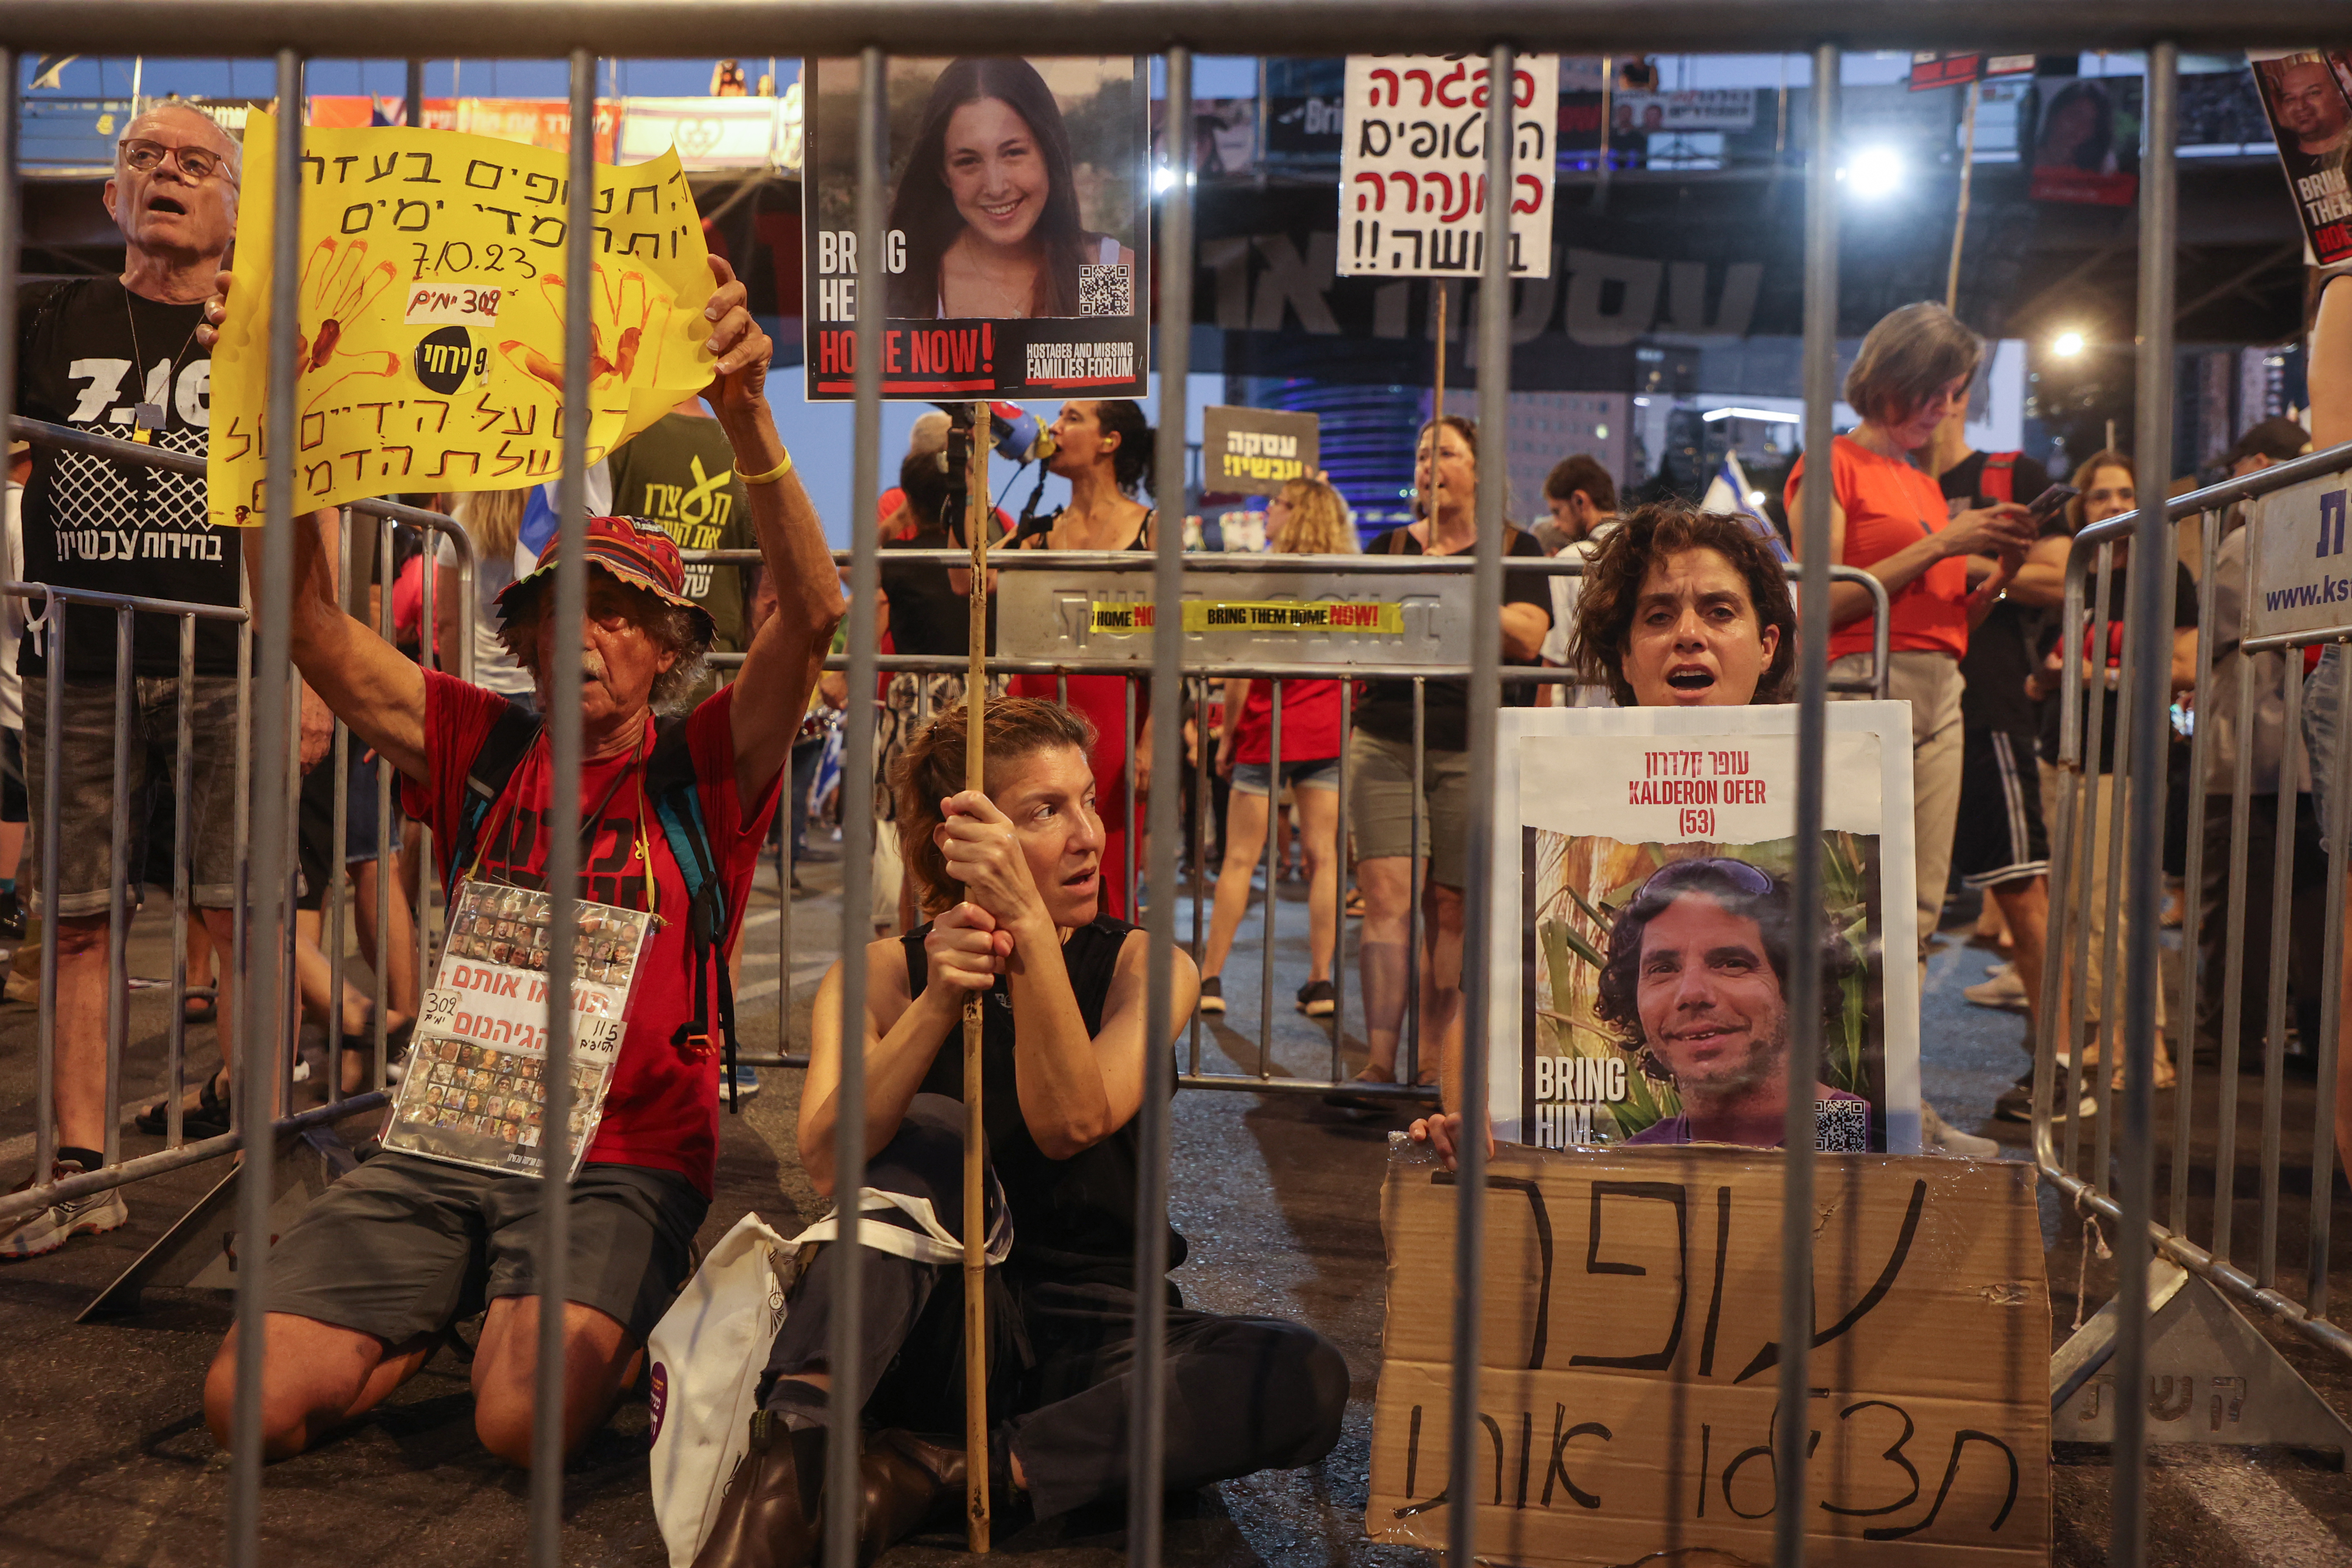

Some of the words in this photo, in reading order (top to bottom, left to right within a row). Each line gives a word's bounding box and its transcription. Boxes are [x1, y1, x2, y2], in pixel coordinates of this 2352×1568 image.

[1361, 112, 1544, 160] הטופים
[1354, 172, 1543, 222] בנהרה
[341, 199, 444, 234] ימים
[819, 230, 906, 274] BRG
[819, 279, 859, 322] HE
[474, 348, 487, 376] 9
[820, 330, 902, 373] HOE
[911, 322, 995, 373] NOW!
[1026, 343, 1072, 358] HOSTAGES
[1074, 343, 1092, 357] AND
[1093, 342, 1133, 357] MISSING
[1026, 357, 1084, 379] FAMILIES
[1088, 357, 1133, 378] FORUM
[477, 393, 536, 435] על
[1227, 430, 1297, 458] עסקה
[1223, 454, 1303, 480] עכשיו!
[55, 530, 139, 561] עכשיו!
[142, 532, 222, 561] בחירות
[2267, 574, 2352, 612] www.ks
[1208, 608, 1246, 624] BRING
[1251, 608, 1286, 624] THEM
[1290, 608, 1327, 625] HOME
[1330, 605, 1378, 626] NOW!
[1645, 750, 1703, 778] קלדרון
[1708, 751, 1749, 775] עופר
[1629, 780, 1718, 805] KALDERON
[1723, 780, 1766, 804] OFER
[1679, 808, 1715, 836] (53)
[452, 965, 521, 998] אותם
[426, 993, 457, 1016] 302
[592, 1020, 618, 1041] 115
[1535, 1056, 1626, 1102] BRING
[1535, 1103, 1594, 1147] HIM
